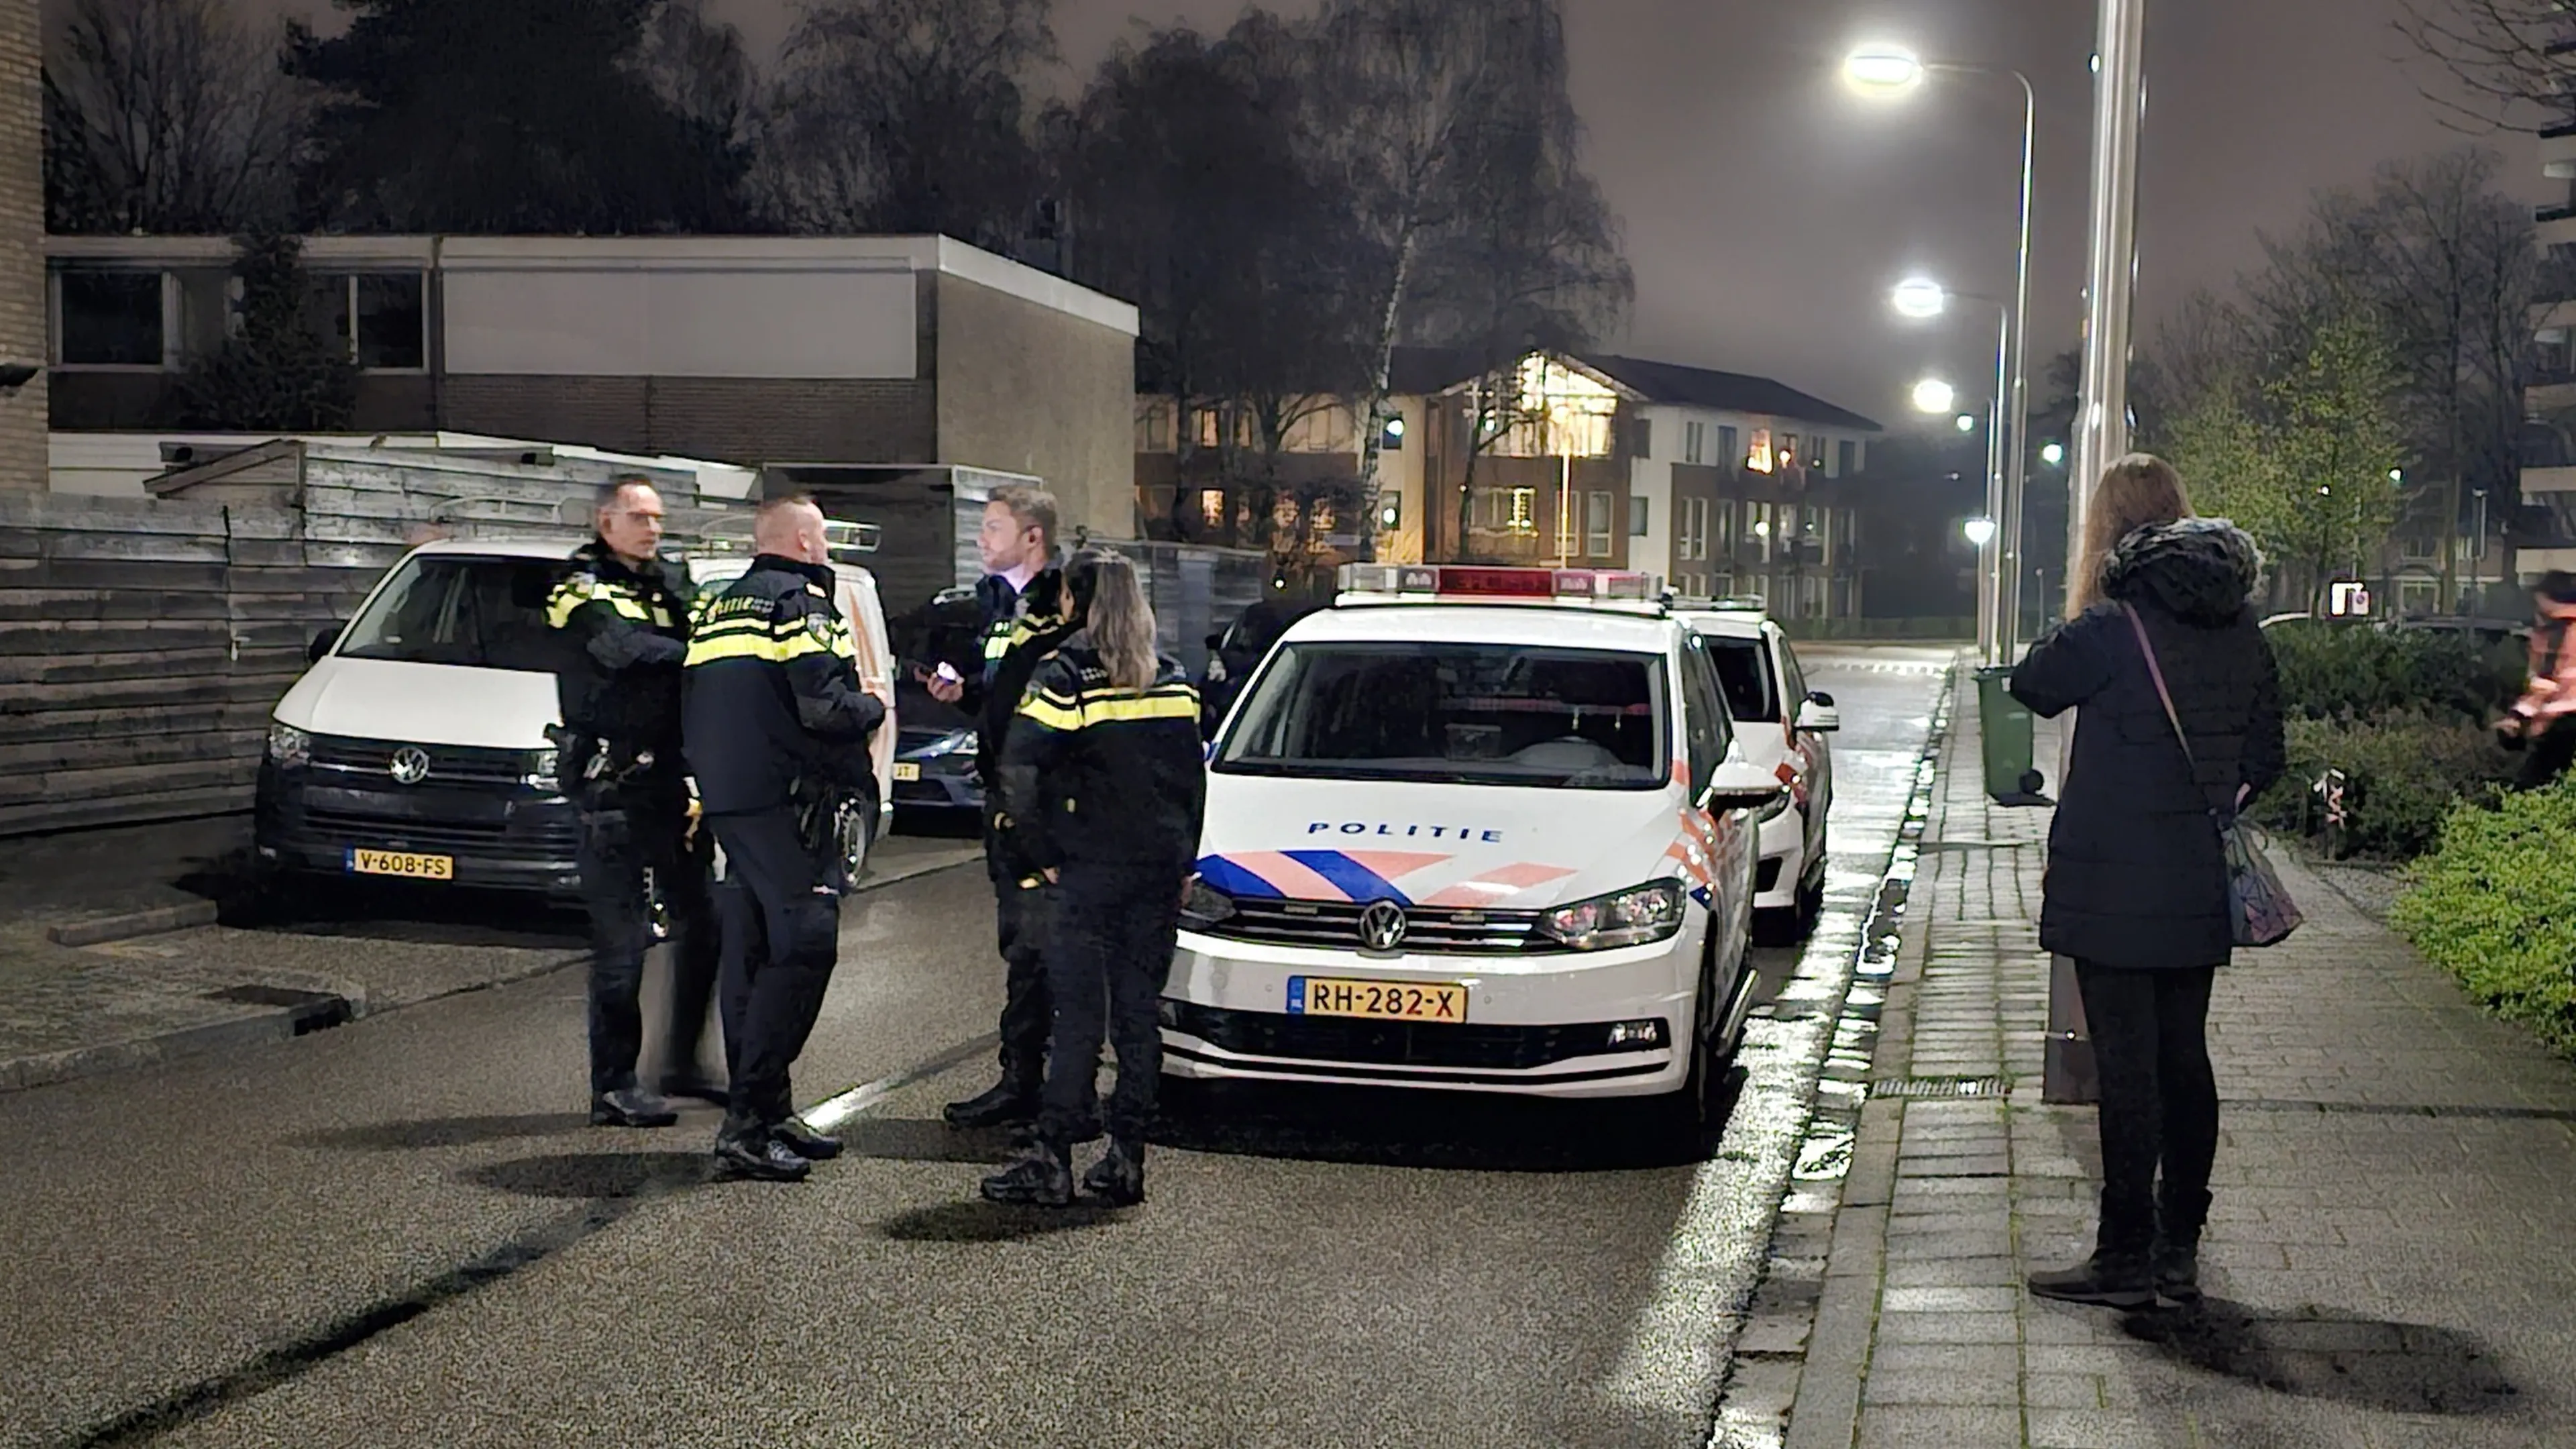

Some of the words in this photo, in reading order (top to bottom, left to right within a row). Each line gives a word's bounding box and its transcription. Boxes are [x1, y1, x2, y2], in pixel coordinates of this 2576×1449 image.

[1308, 822, 1503, 843] POLITIE
[361, 853, 445, 875] V-608-FS
[1313, 983, 1454, 1018] RH-282-X
